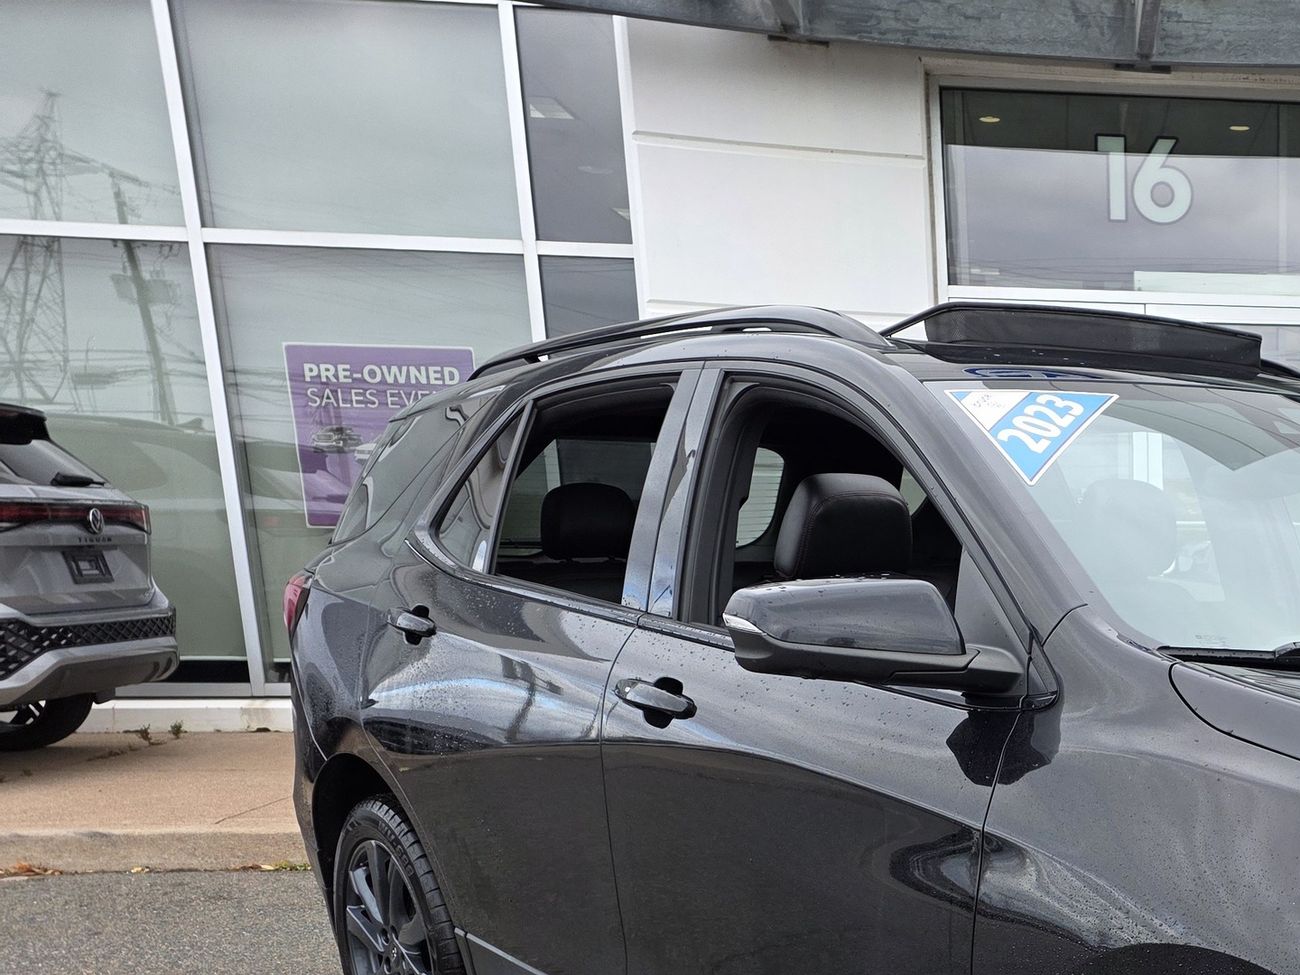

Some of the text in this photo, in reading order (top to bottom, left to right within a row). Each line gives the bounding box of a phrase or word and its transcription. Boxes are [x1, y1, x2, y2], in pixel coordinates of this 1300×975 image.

[1096, 134, 1193, 224] 16
[303, 363, 460, 386] PRE-OWNED
[306, 388, 378, 408] SALES
[997, 394, 1084, 454] 2023
